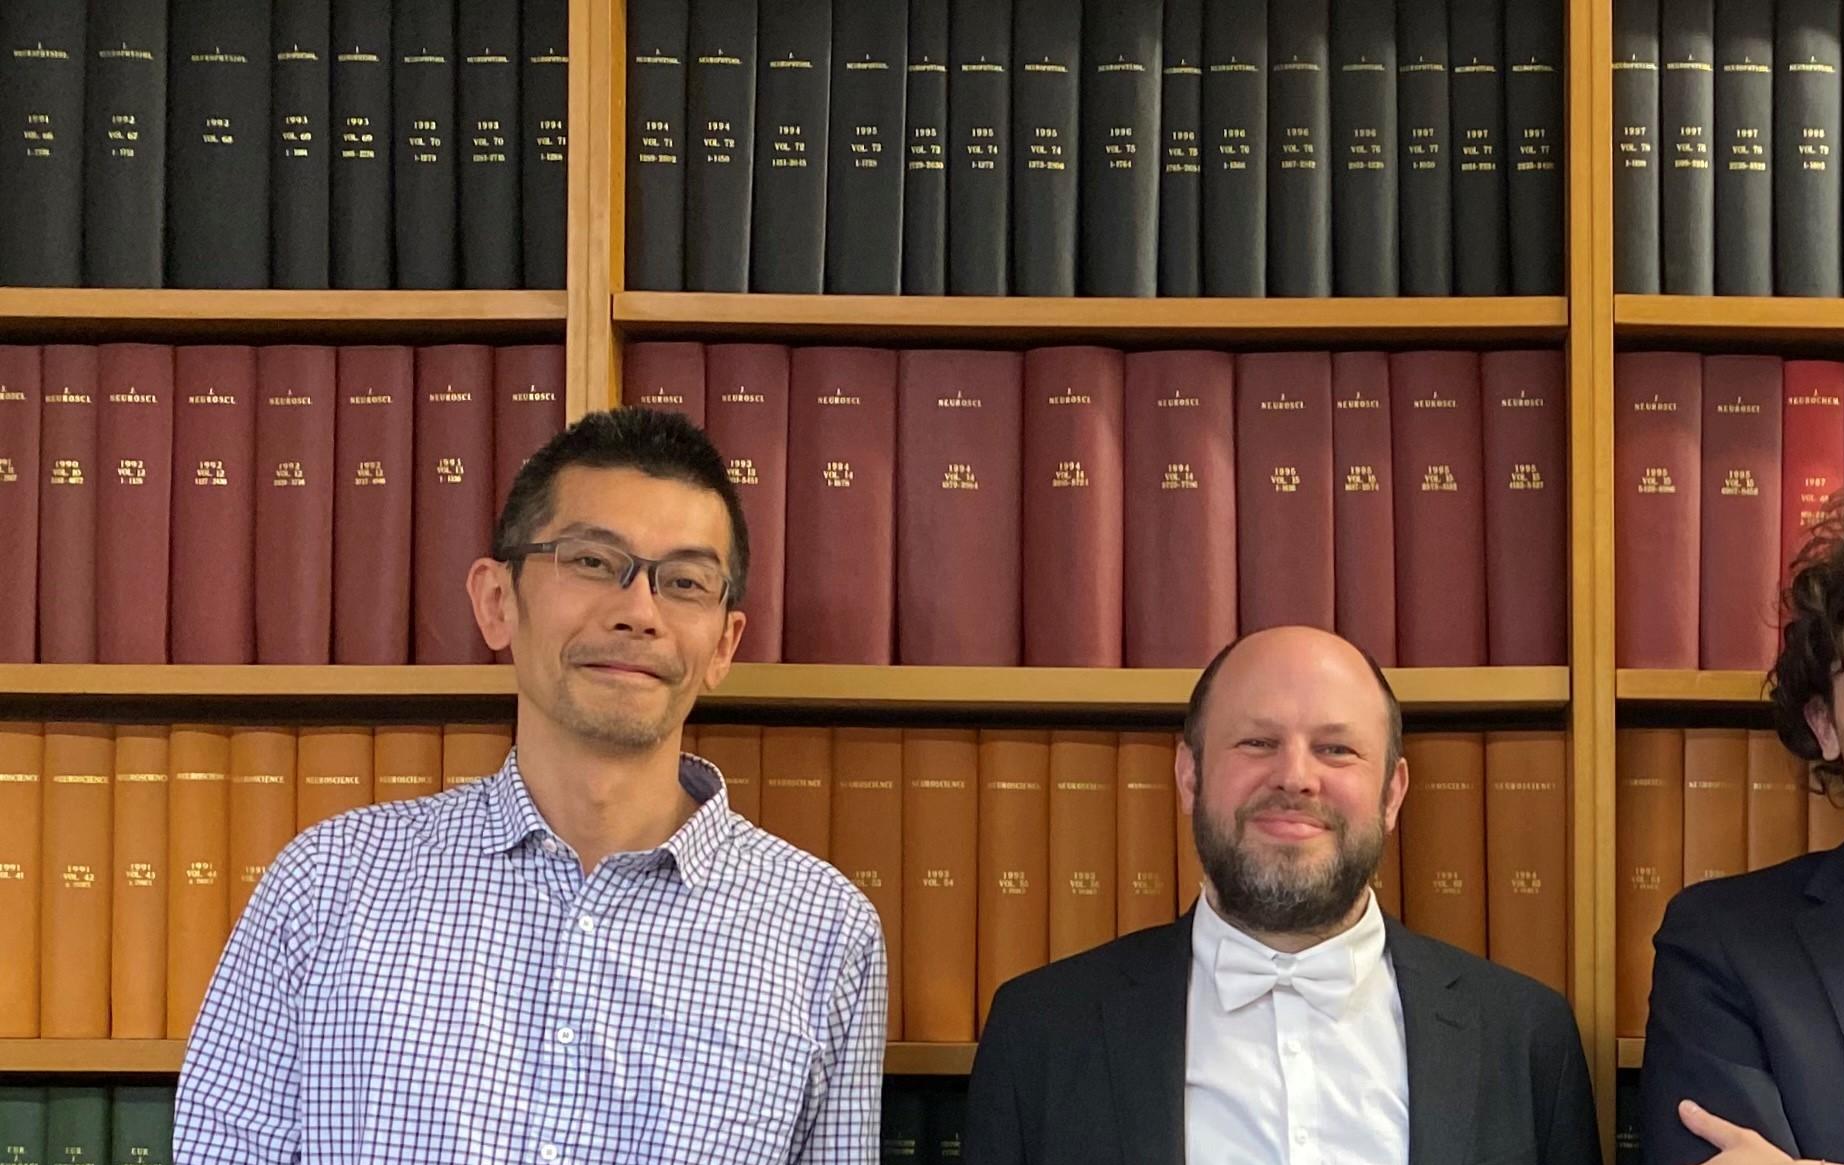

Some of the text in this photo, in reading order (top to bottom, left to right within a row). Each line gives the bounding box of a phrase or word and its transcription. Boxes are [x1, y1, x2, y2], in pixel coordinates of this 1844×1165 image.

[646, 121, 669, 131] 1994
[708, 121, 731, 131] 1994
[1624, 126, 1647, 136] 1997
[1680, 126, 1702, 136] 1997
[1412, 127, 1434, 137] 1997
[1466, 129, 1489, 139] 1997
[1736, 128, 1759, 138] 1997
